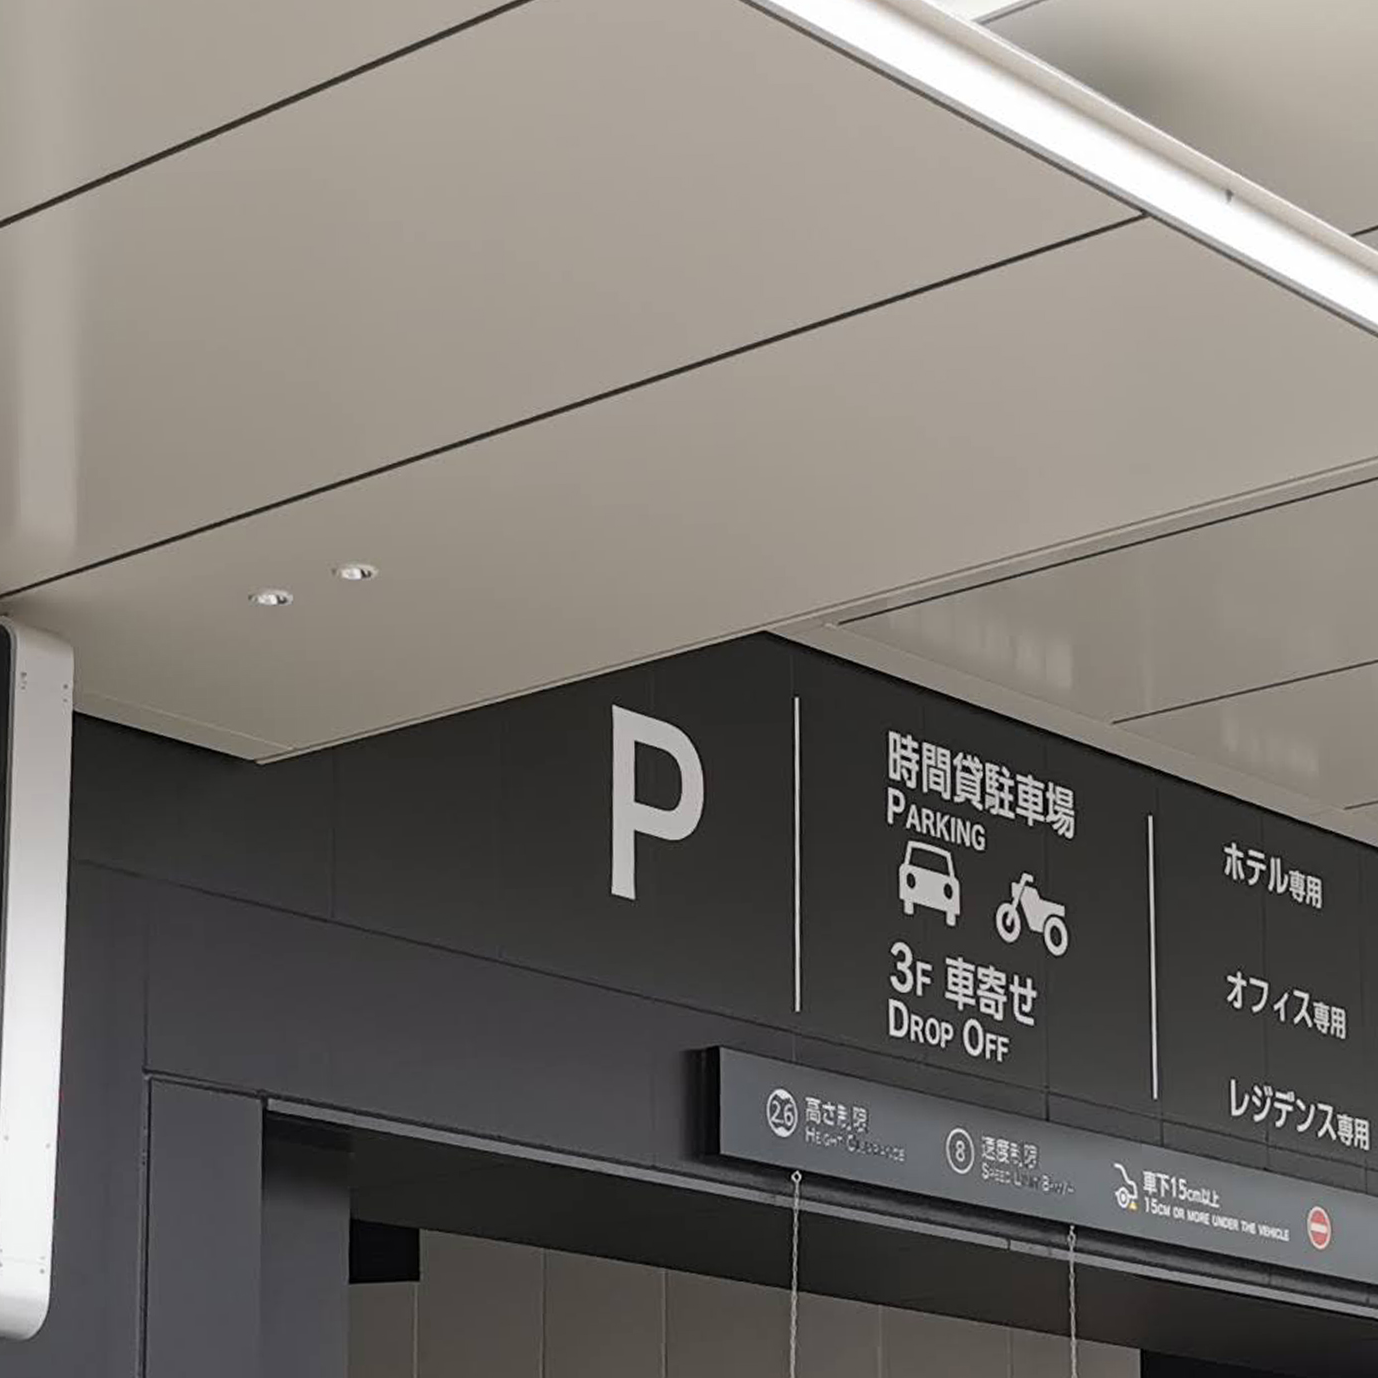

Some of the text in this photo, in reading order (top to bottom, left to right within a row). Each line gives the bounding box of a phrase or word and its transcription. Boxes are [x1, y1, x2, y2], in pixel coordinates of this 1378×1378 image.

[611, 703, 705, 900] P
[886, 731, 1076, 839] 時間貸駐車場
[1224, 843, 1322, 909] ホテル専用
[945, 957, 1037, 1026] 車寄せ
[1226, 971, 1347, 1039] オフィス専用
[1229, 1079, 1370, 1150] レジデンス専用
[1173, 1206, 1185, 1219] OR
[1187, 1209, 1209, 1225] MORE
[1212, 1214, 1239, 1231] UNDER
[1240, 1220, 1256, 1235] THE
[1258, 1224, 1290, 1242] VEHICLE
